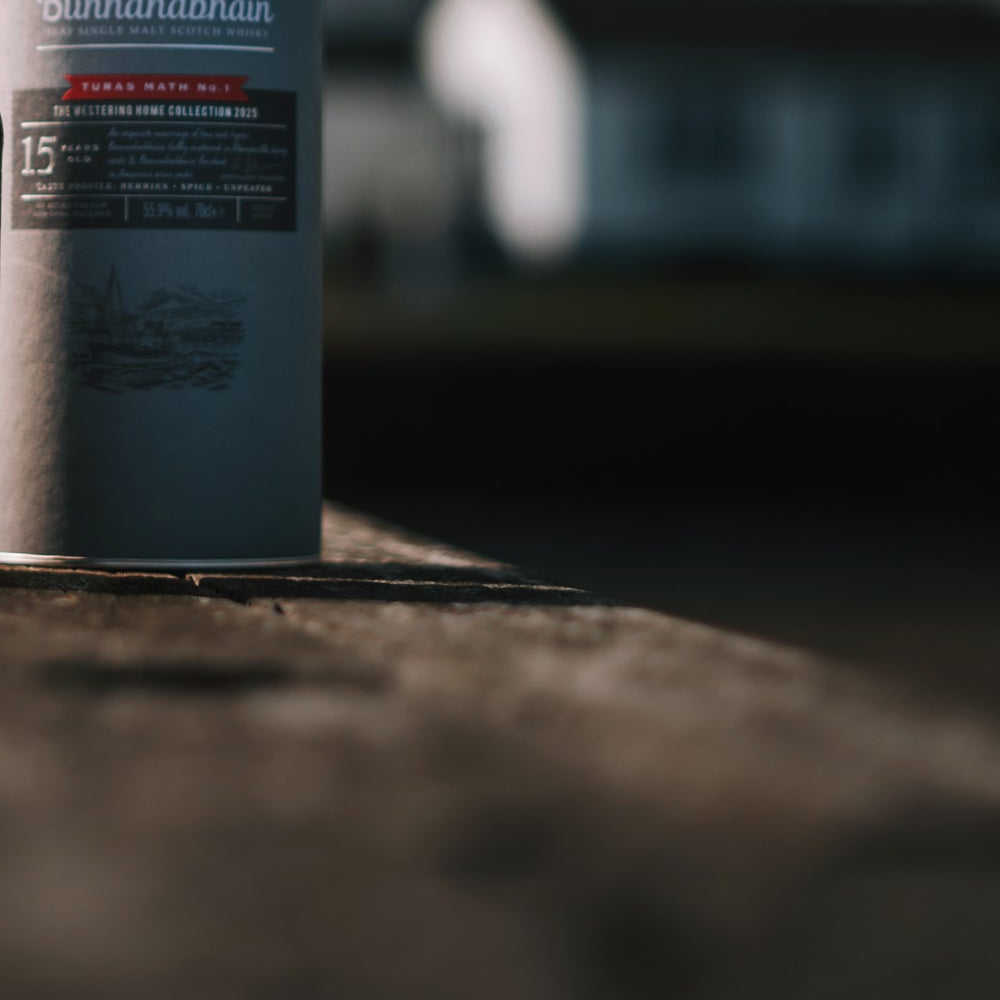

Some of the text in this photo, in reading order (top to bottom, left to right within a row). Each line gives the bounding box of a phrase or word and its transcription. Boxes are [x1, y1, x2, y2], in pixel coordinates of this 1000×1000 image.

[129, 25, 166, 36] MALT
[170, 25, 221, 37] SCOTCH
[80, 81, 136, 92] TURAS
[143, 81, 190, 93] MATH
[73, 104, 134, 117] WESTERING
[135, 104, 165, 117] HOME
[168, 105, 233, 118] COLLECTION
[234, 106, 259, 119] 2025
[20, 135, 58, 176] 15
